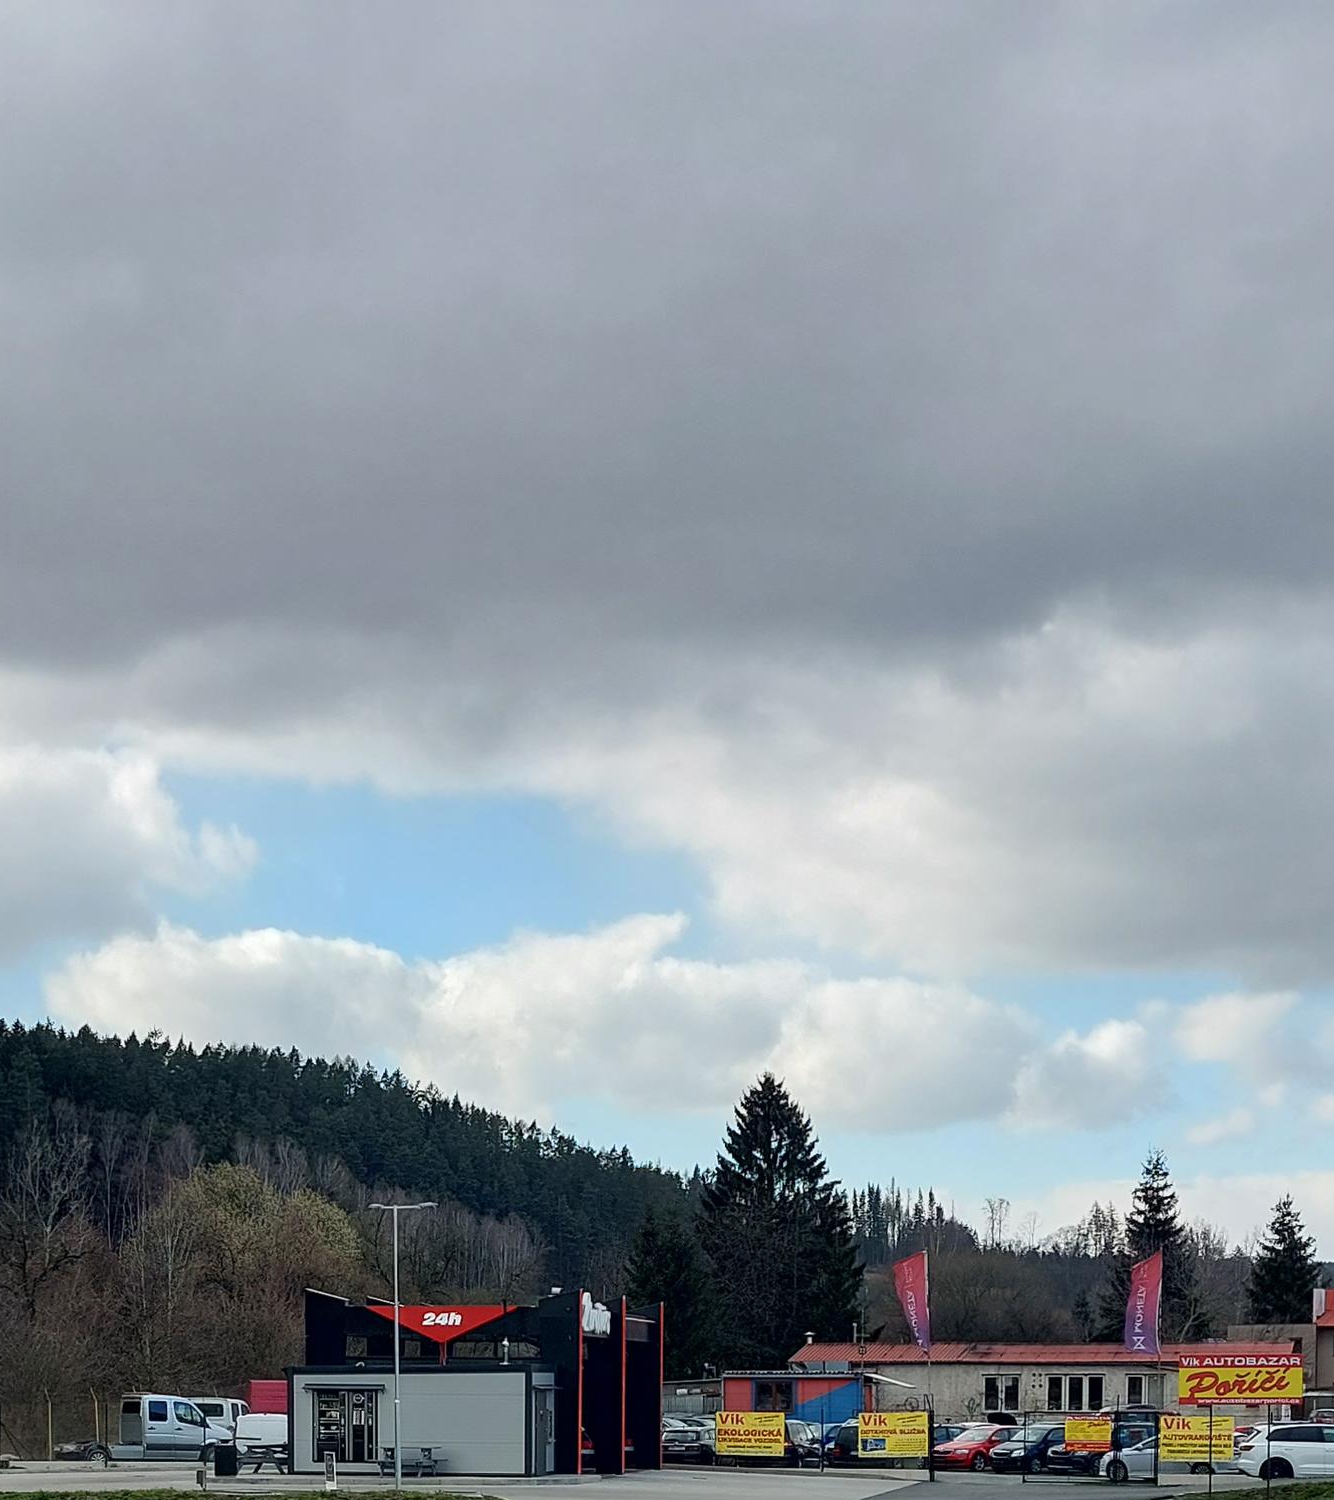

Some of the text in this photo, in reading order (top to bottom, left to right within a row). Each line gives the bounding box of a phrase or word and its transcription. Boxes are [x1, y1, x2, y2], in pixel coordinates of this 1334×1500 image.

[422, 1312, 462, 1326] 24h
[1181, 1357, 1301, 1366] Vik AUTOBAZAR
[1186, 1367, 1290, 1400] Poříčí
[719, 1414, 744, 1425] Vik
[861, 1414, 887, 1426] Vik
[1163, 1418, 1191, 1429] Vik
[718, 1428, 782, 1437] EKOLOGICKÁ
